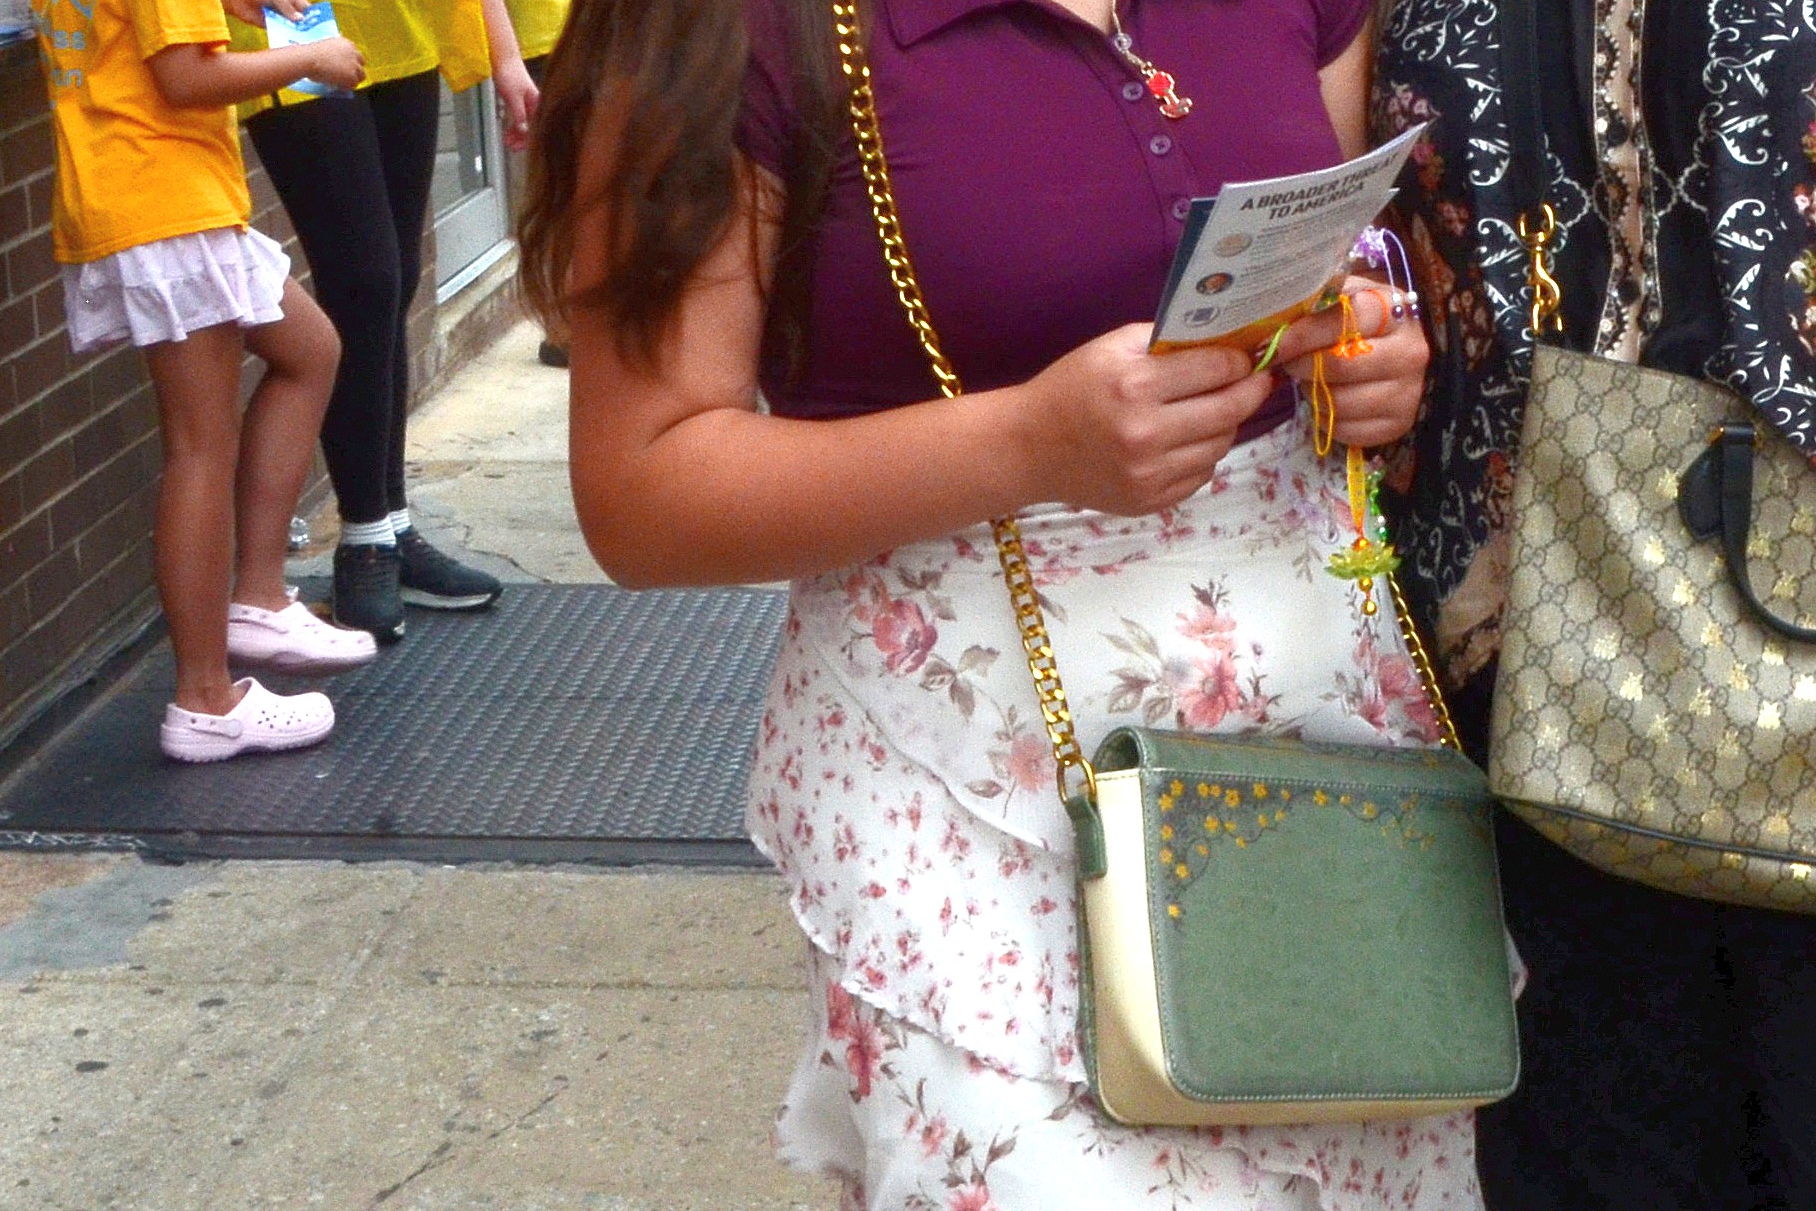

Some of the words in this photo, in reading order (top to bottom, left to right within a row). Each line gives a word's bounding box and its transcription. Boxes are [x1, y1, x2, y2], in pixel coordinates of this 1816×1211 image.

[1240, 197, 1254, 211] A
[1257, 179, 1340, 207] BROADER
[1268, 206, 1291, 220] TO
[1291, 182, 1365, 216] AMERICA
